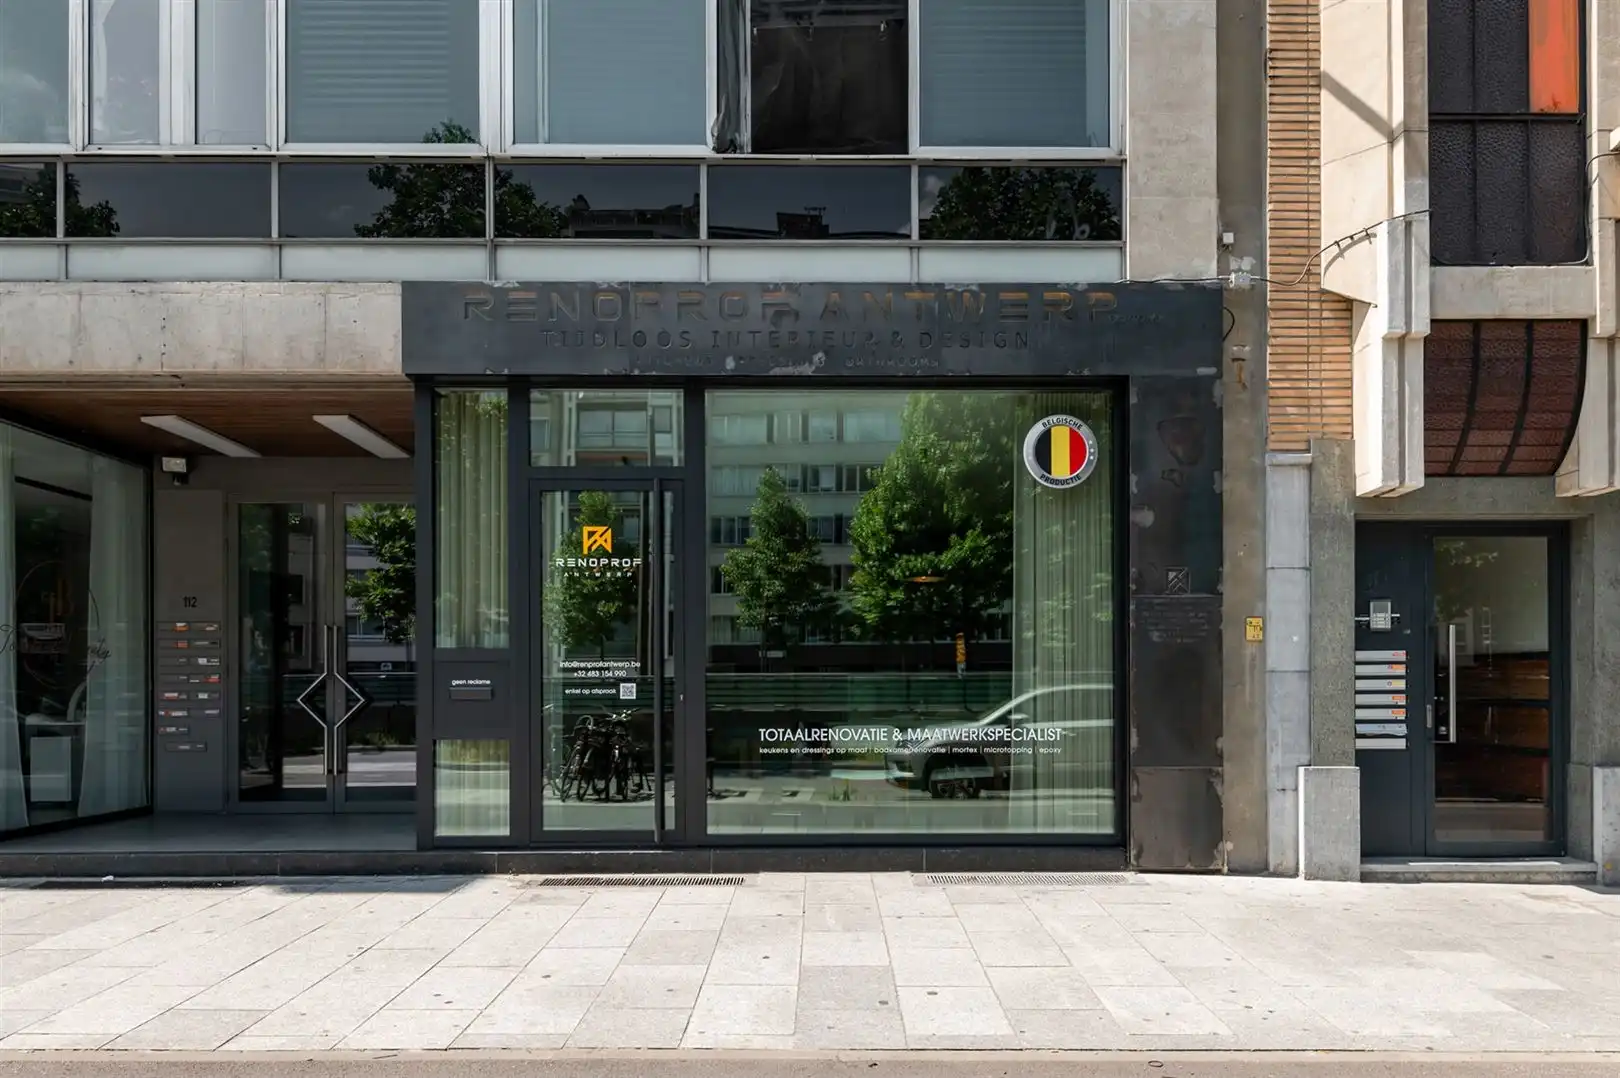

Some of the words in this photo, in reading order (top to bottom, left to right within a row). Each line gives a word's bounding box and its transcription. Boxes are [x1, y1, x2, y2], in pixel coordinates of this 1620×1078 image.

[818, 291, 1118, 323] ANTWERP
[542, 329, 692, 349] TIJDLOOS
[711, 329, 878, 349] INTERIEUR
[891, 330, 906, 349] &
[918, 329, 1030, 349] DESIGN
[1041, 417, 1083, 431] BELGISCHE
[1040, 473, 1082, 486] PRODUCTIE
[555, 558, 642, 567] RENOPROF
[183, 596, 198, 608] 112
[573, 670, 586, 678] +32
[614, 670, 627, 678] 990
[758, 728, 888, 741] TOTAALRENOVATIE
[891, 728, 903, 742] &
[906, 728, 1062, 741] MAATWERKSPECIALIST
[801, 747, 835, 756] dressings
[835, 748, 846, 756] op
[983, 746, 1033, 755] microtopping
[1038, 747, 1062, 755] epoxy
